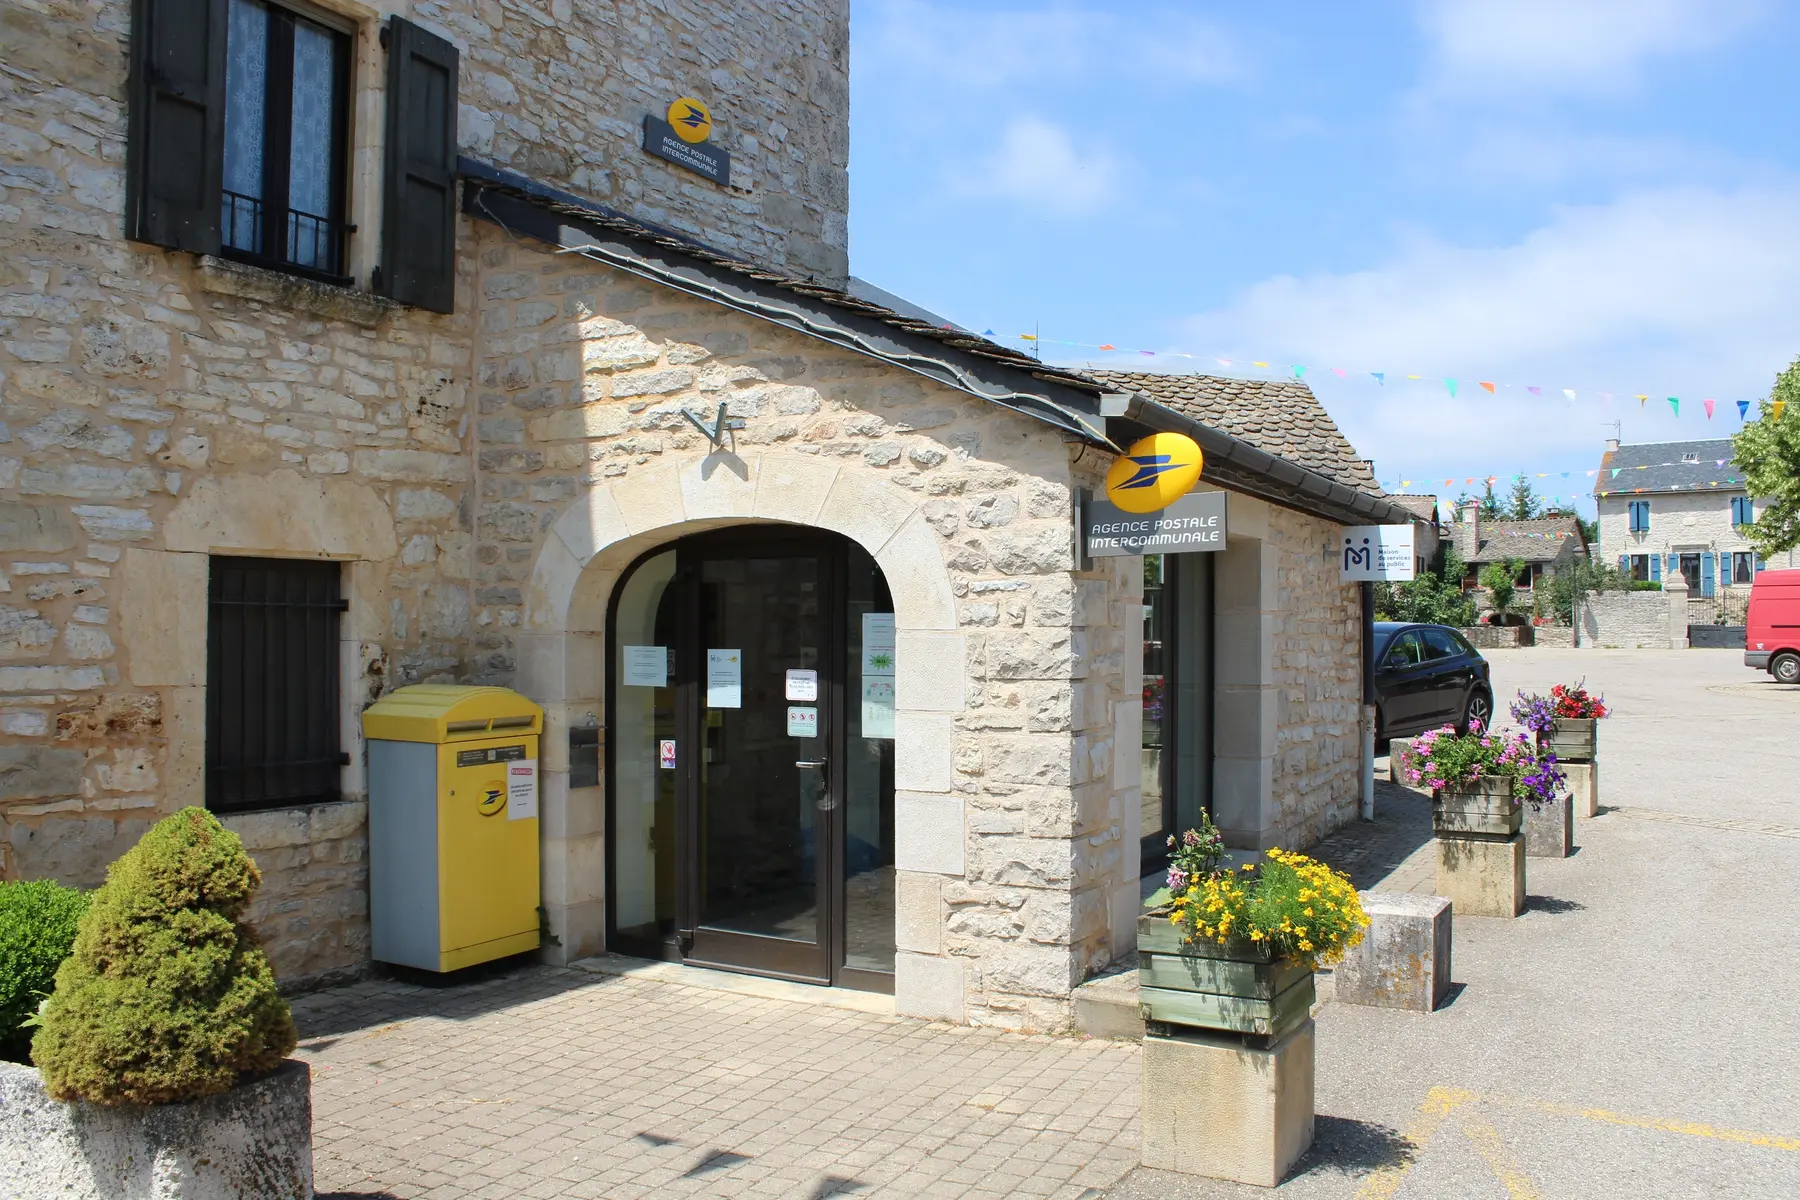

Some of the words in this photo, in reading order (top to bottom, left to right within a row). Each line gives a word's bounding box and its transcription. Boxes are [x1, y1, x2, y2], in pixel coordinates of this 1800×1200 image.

[662, 145, 718, 176] INTERCOMMUNALE
[663, 136, 689, 154] AGENCE
[691, 149, 717, 167] POSTALE
[1091, 520, 1150, 534] AGENCE
[1154, 516, 1218, 530] POSTALE
[1090, 531, 1220, 549] INTERCOMMUNALE
